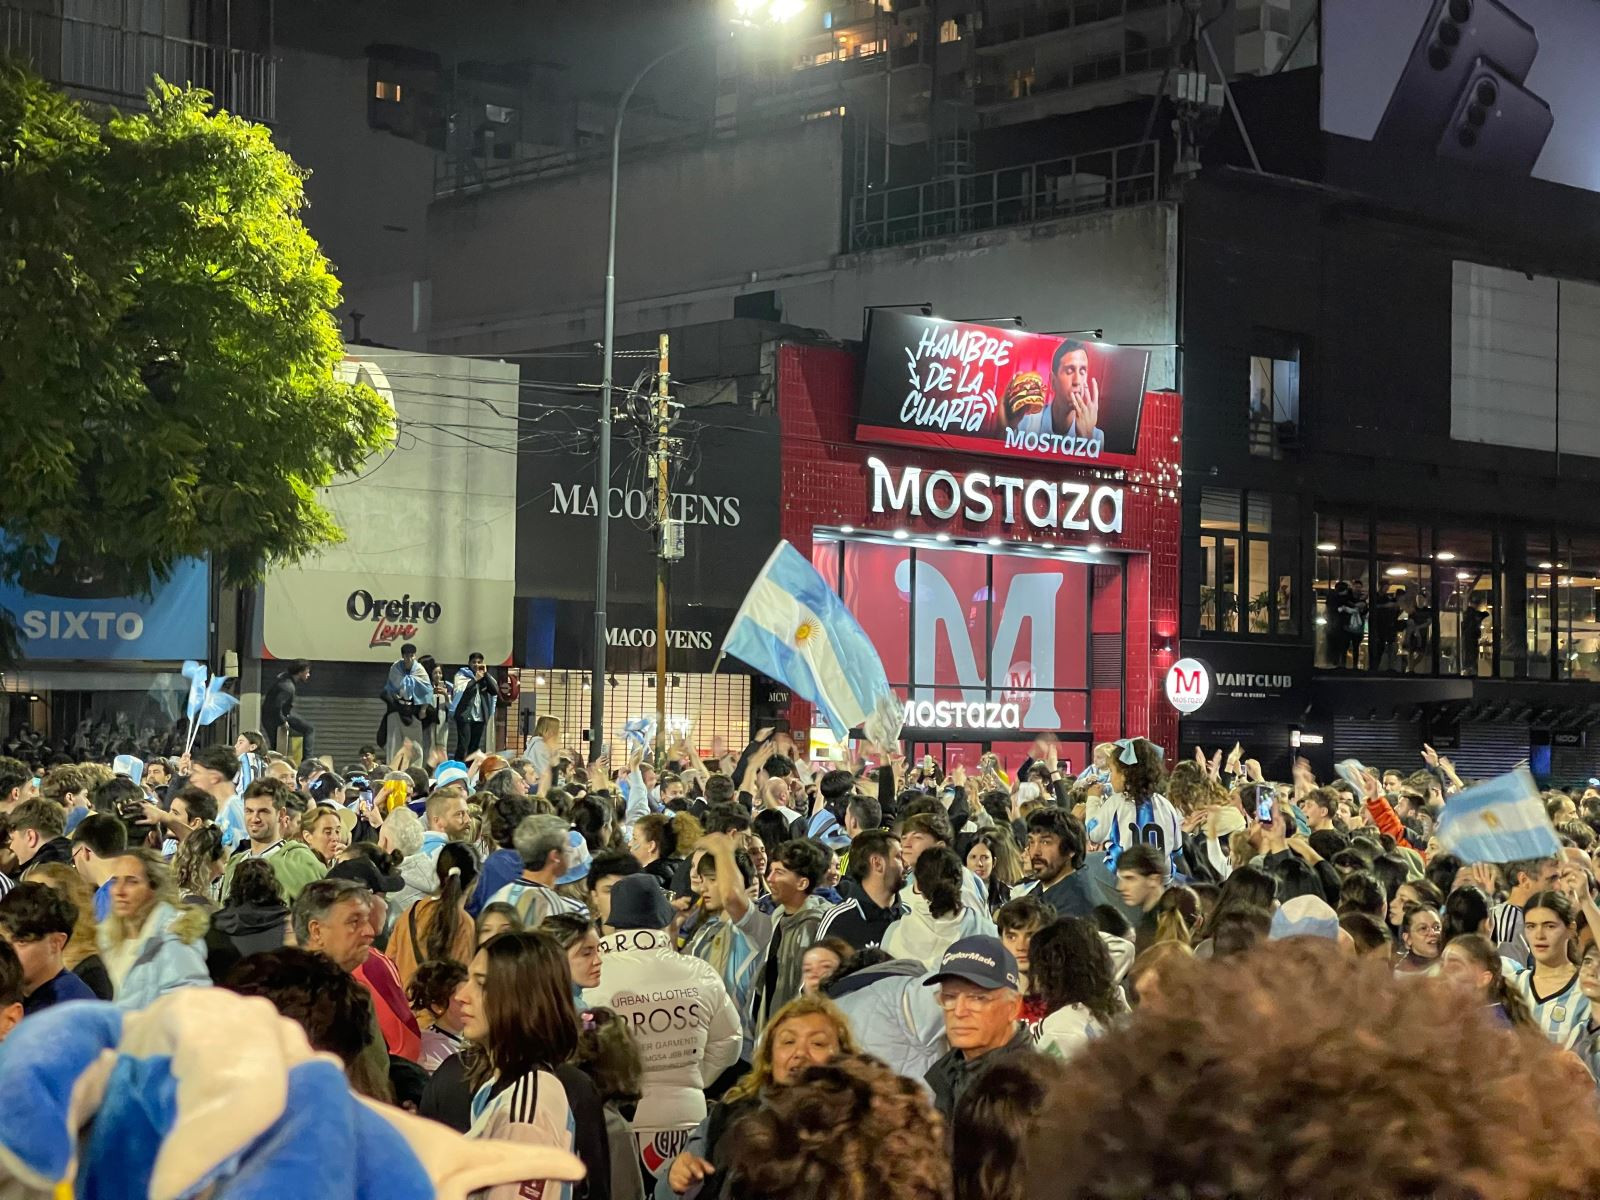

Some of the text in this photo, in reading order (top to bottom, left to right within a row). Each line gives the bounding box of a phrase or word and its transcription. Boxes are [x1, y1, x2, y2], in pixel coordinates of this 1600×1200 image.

[915, 326, 1014, 367] HAMBRE
[923, 362, 984, 394] DE LA
[550, 482, 740, 527] MACOENS
[346, 589, 442, 624] Oreiro
[23, 610, 144, 641] SIXTO
[1174, 666, 1201, 694] M
[1215, 672, 1292, 688] VANTCLUB
[1128, 822, 1165, 852] 10
[611, 987, 699, 1008] URBAN CLOTHES
